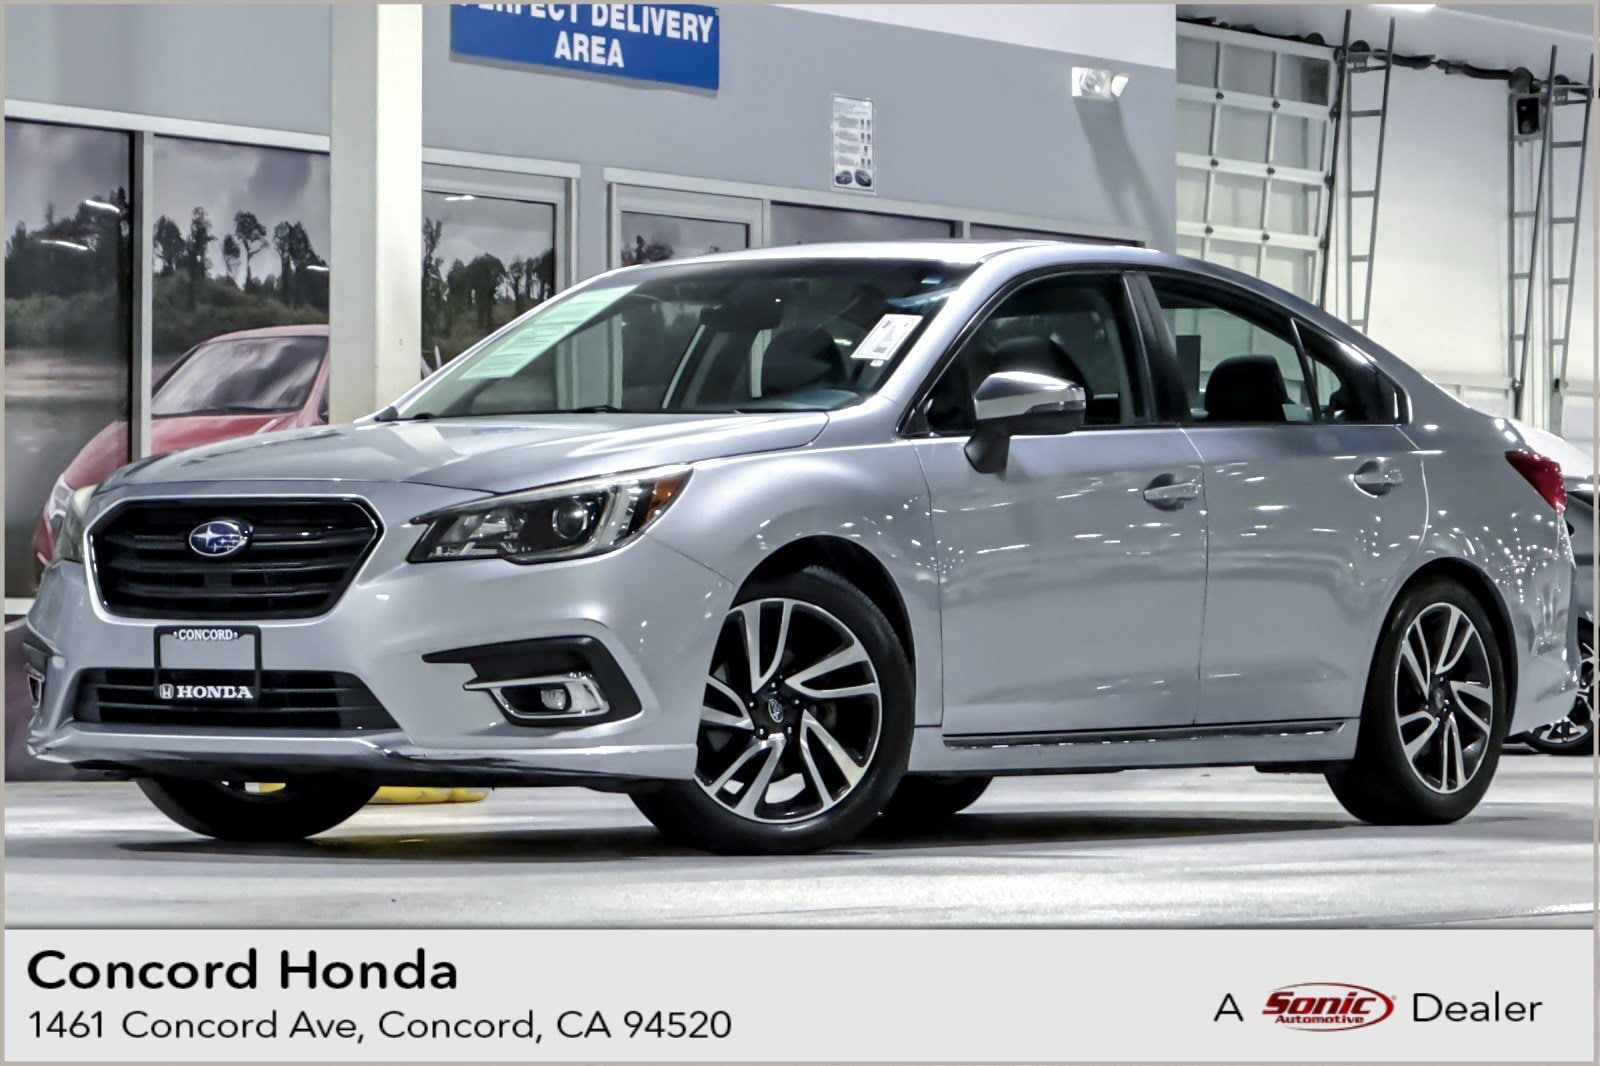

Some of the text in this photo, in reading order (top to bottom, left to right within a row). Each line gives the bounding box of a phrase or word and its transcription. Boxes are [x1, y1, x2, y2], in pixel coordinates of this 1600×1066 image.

[591, 4, 714, 44] DELIVERY
[554, 30, 625, 68] AREA
[178, 629, 234, 640] CONCORD
[176, 685, 254, 699] HONDA
